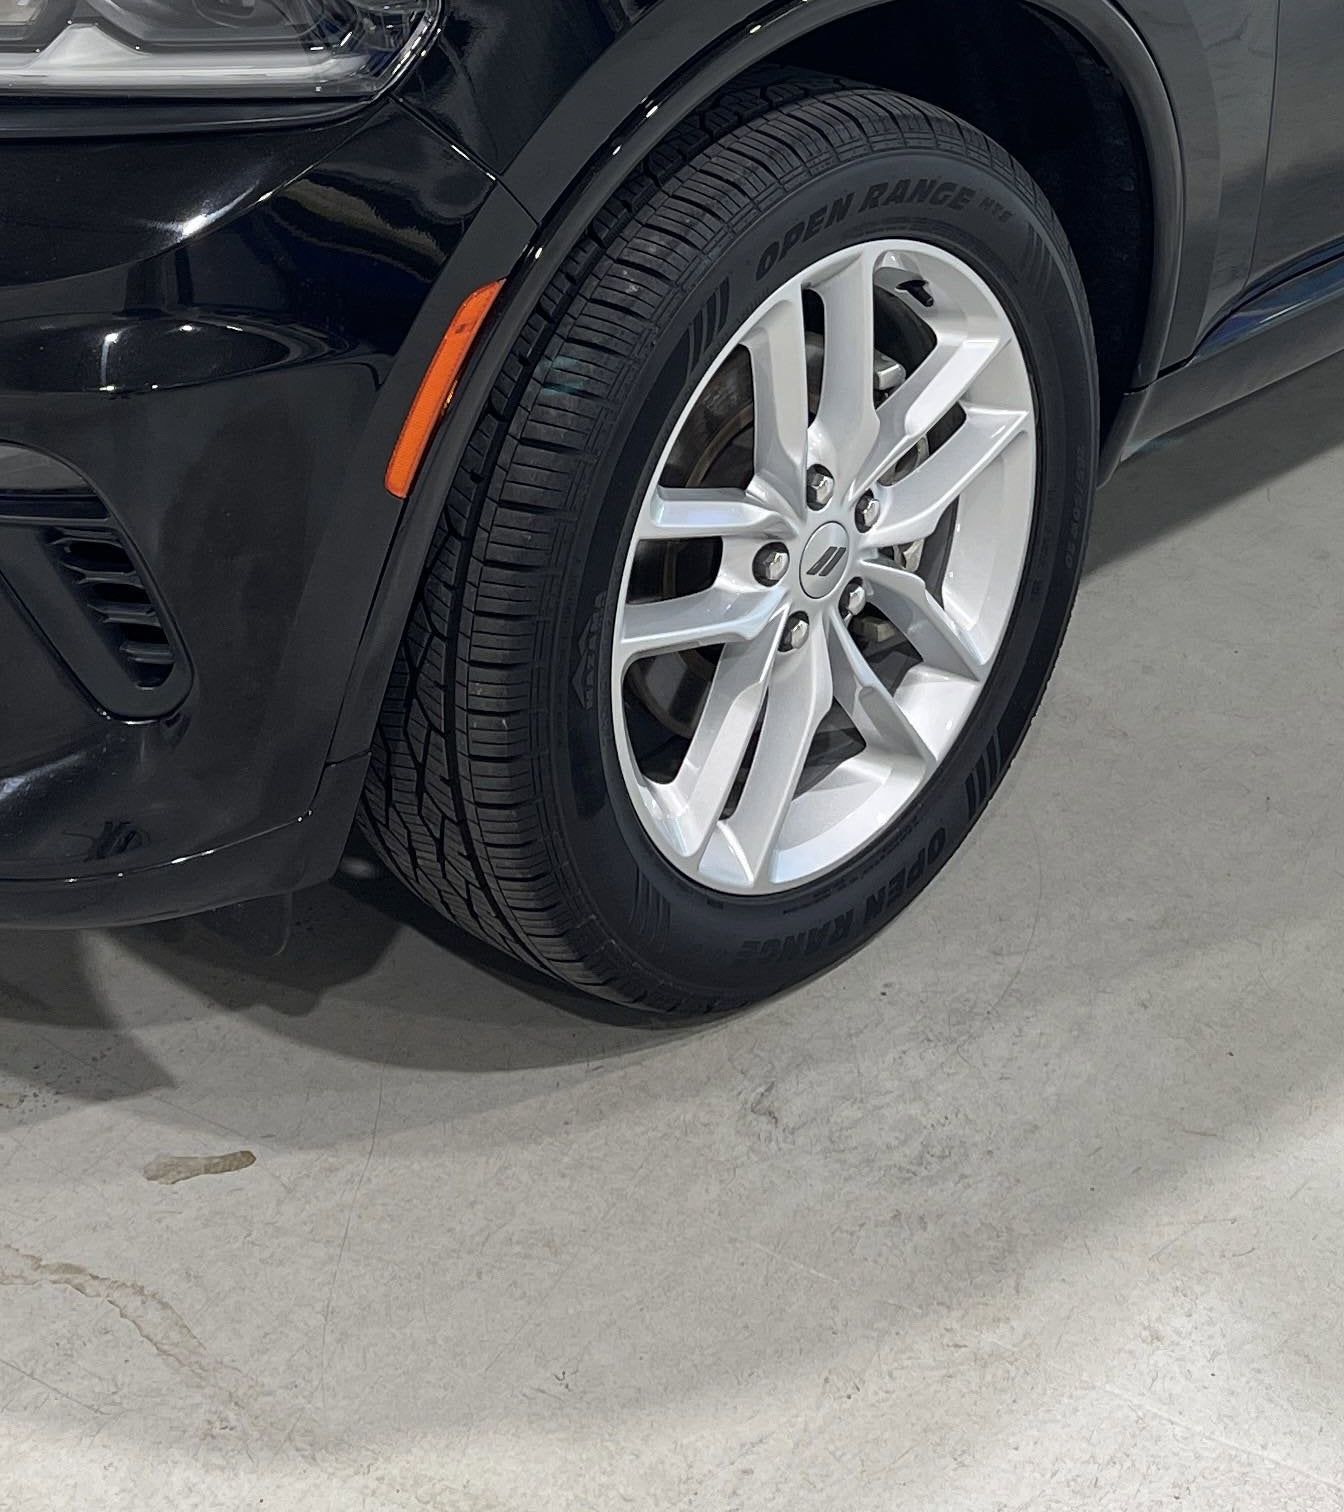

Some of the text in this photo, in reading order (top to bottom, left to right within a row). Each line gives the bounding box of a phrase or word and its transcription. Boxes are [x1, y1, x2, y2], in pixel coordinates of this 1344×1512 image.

[756, 192, 854, 282] OPEN
[858, 177, 977, 214] RANGE
[863, 826, 947, 926] OPEN
